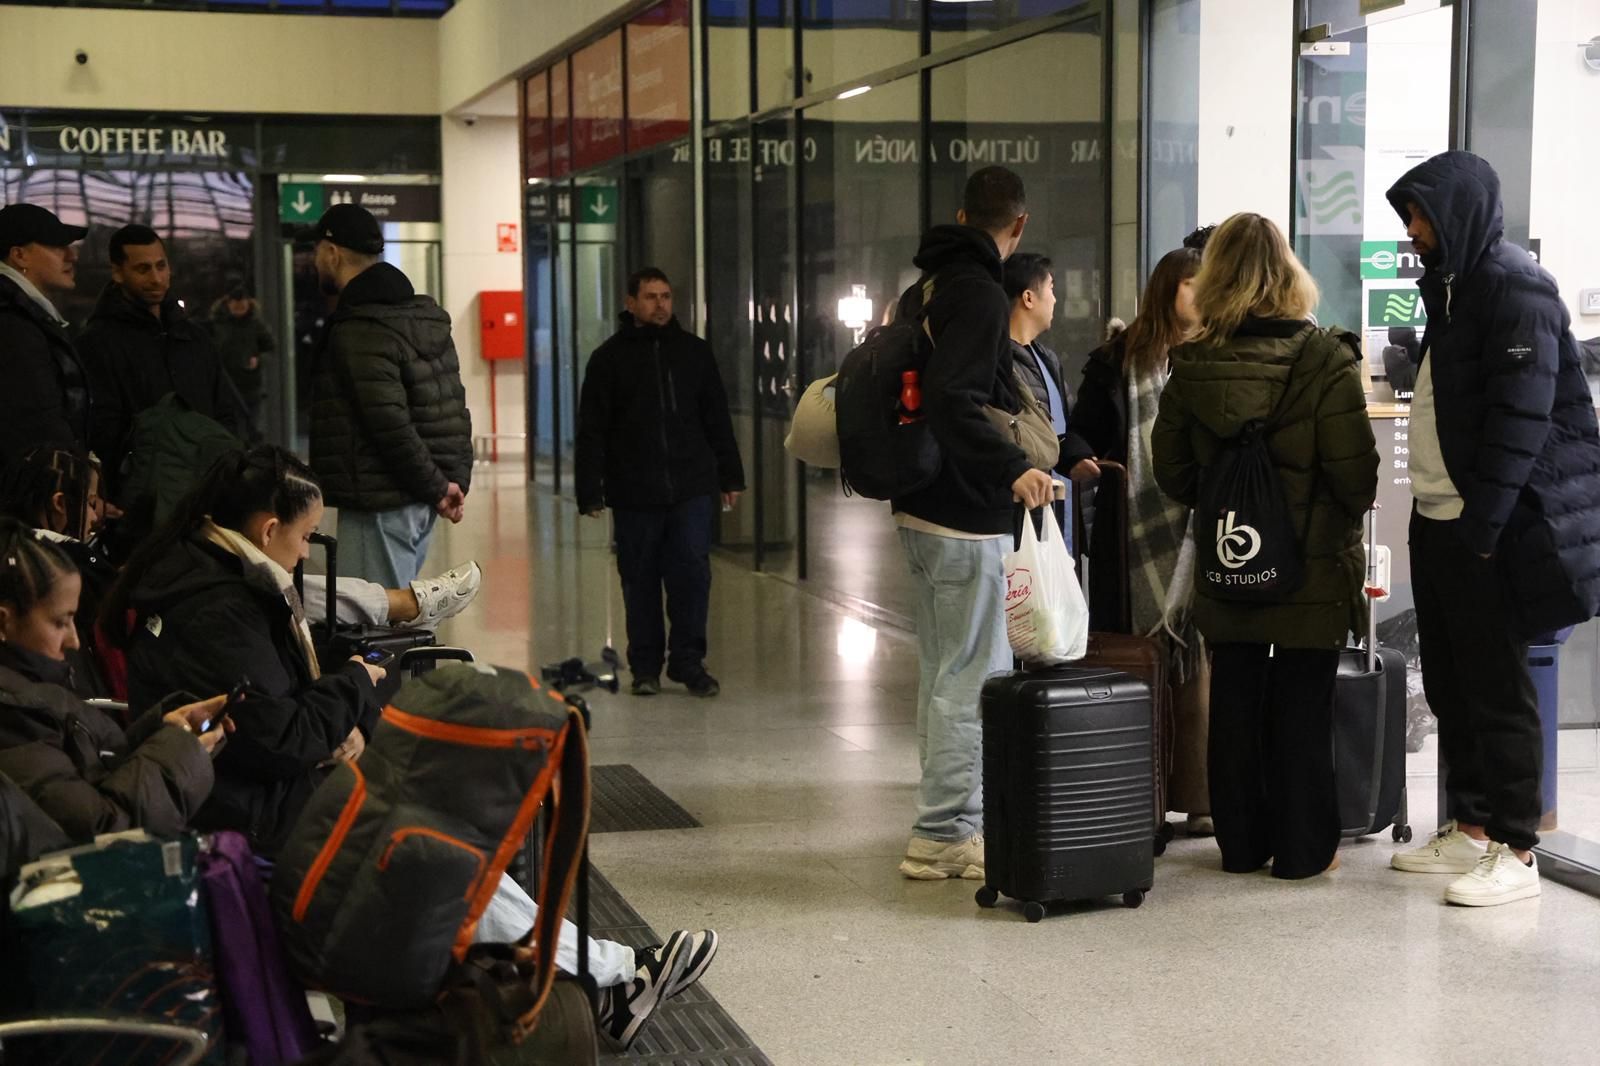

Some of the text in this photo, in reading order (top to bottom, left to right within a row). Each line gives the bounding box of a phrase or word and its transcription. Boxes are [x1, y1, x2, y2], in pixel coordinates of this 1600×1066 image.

[59, 126, 227, 157] COFFEE BAR
[1394, 418, 1410, 427] Sá
[1224, 567, 1277, 585] STUDIOS
